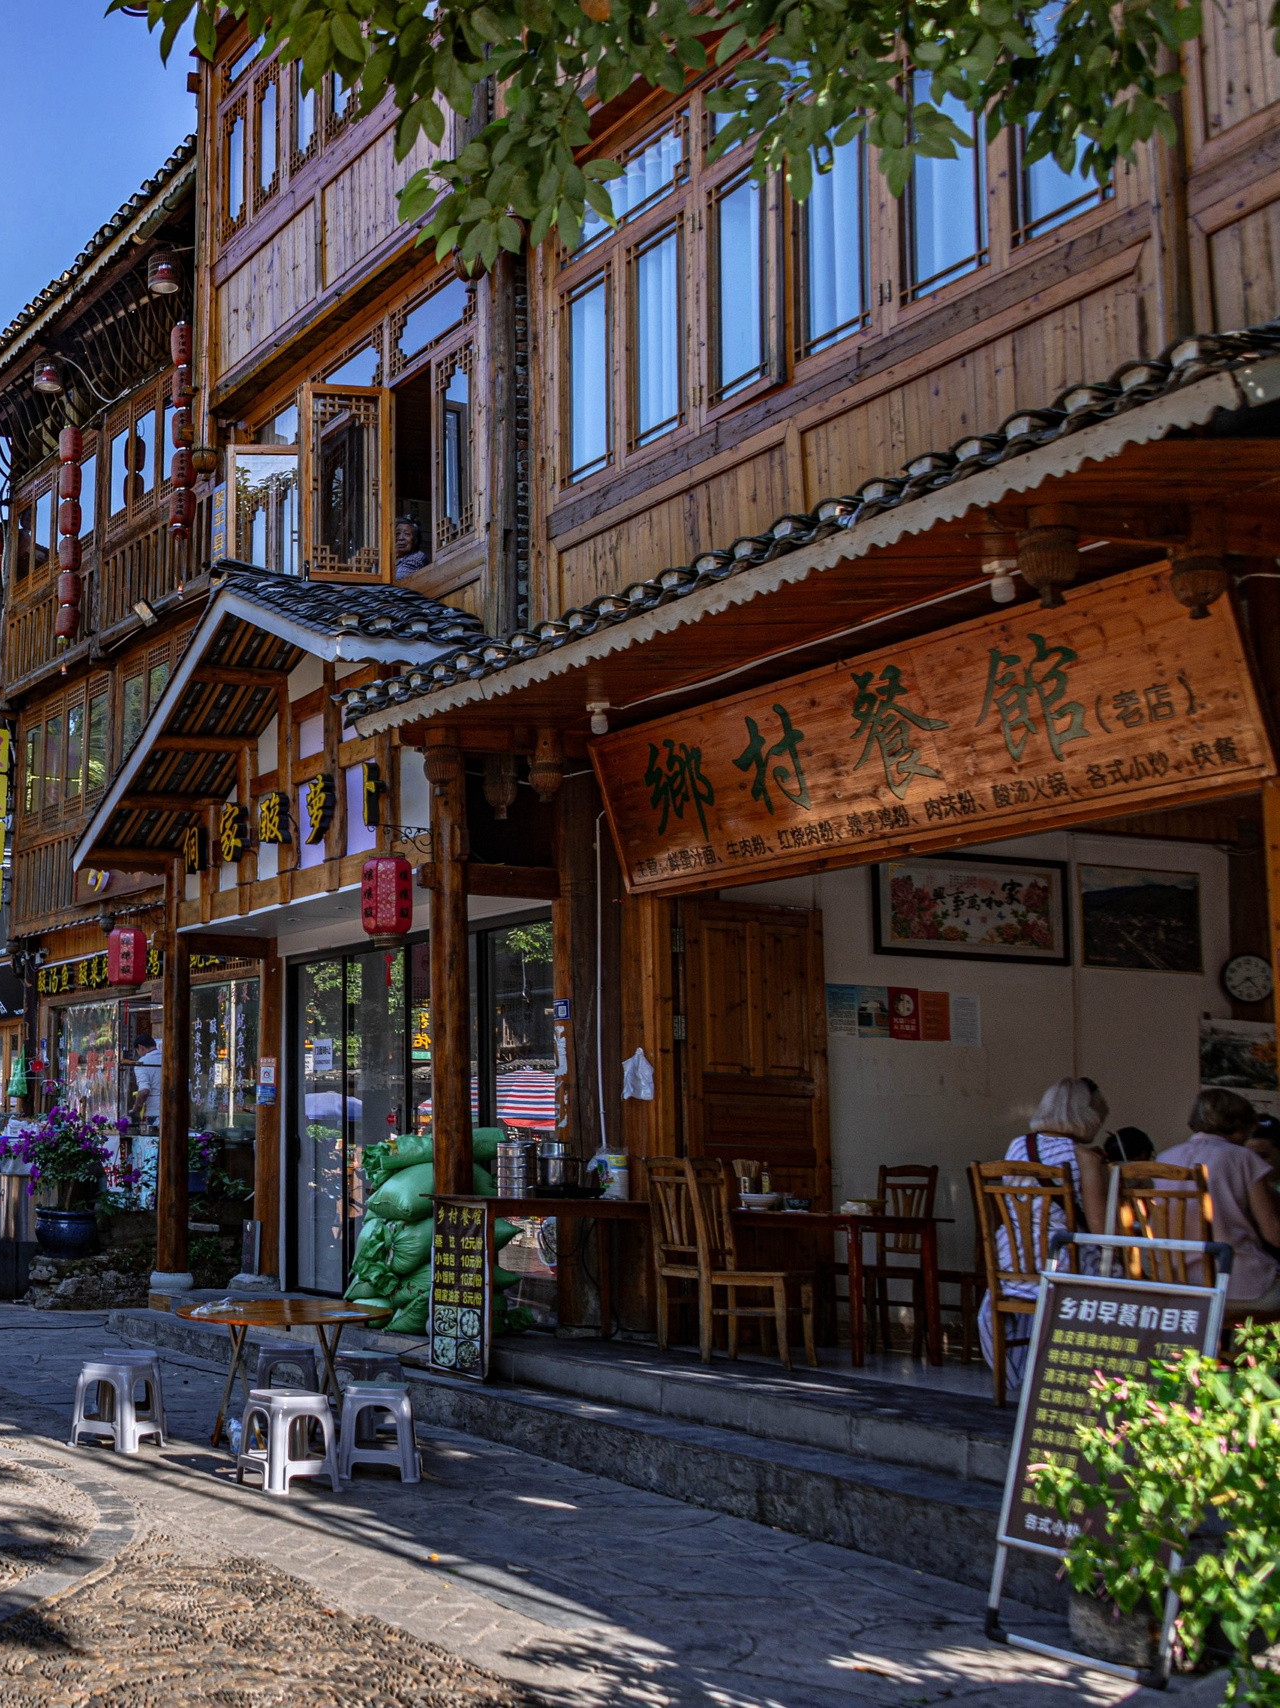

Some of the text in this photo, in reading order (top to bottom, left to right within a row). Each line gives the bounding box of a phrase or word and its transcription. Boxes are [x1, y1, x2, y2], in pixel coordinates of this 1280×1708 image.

[436, 1206, 482, 1226] 乡村餐馆
[1058, 1297, 1200, 1335] 乡村早餐价目表
